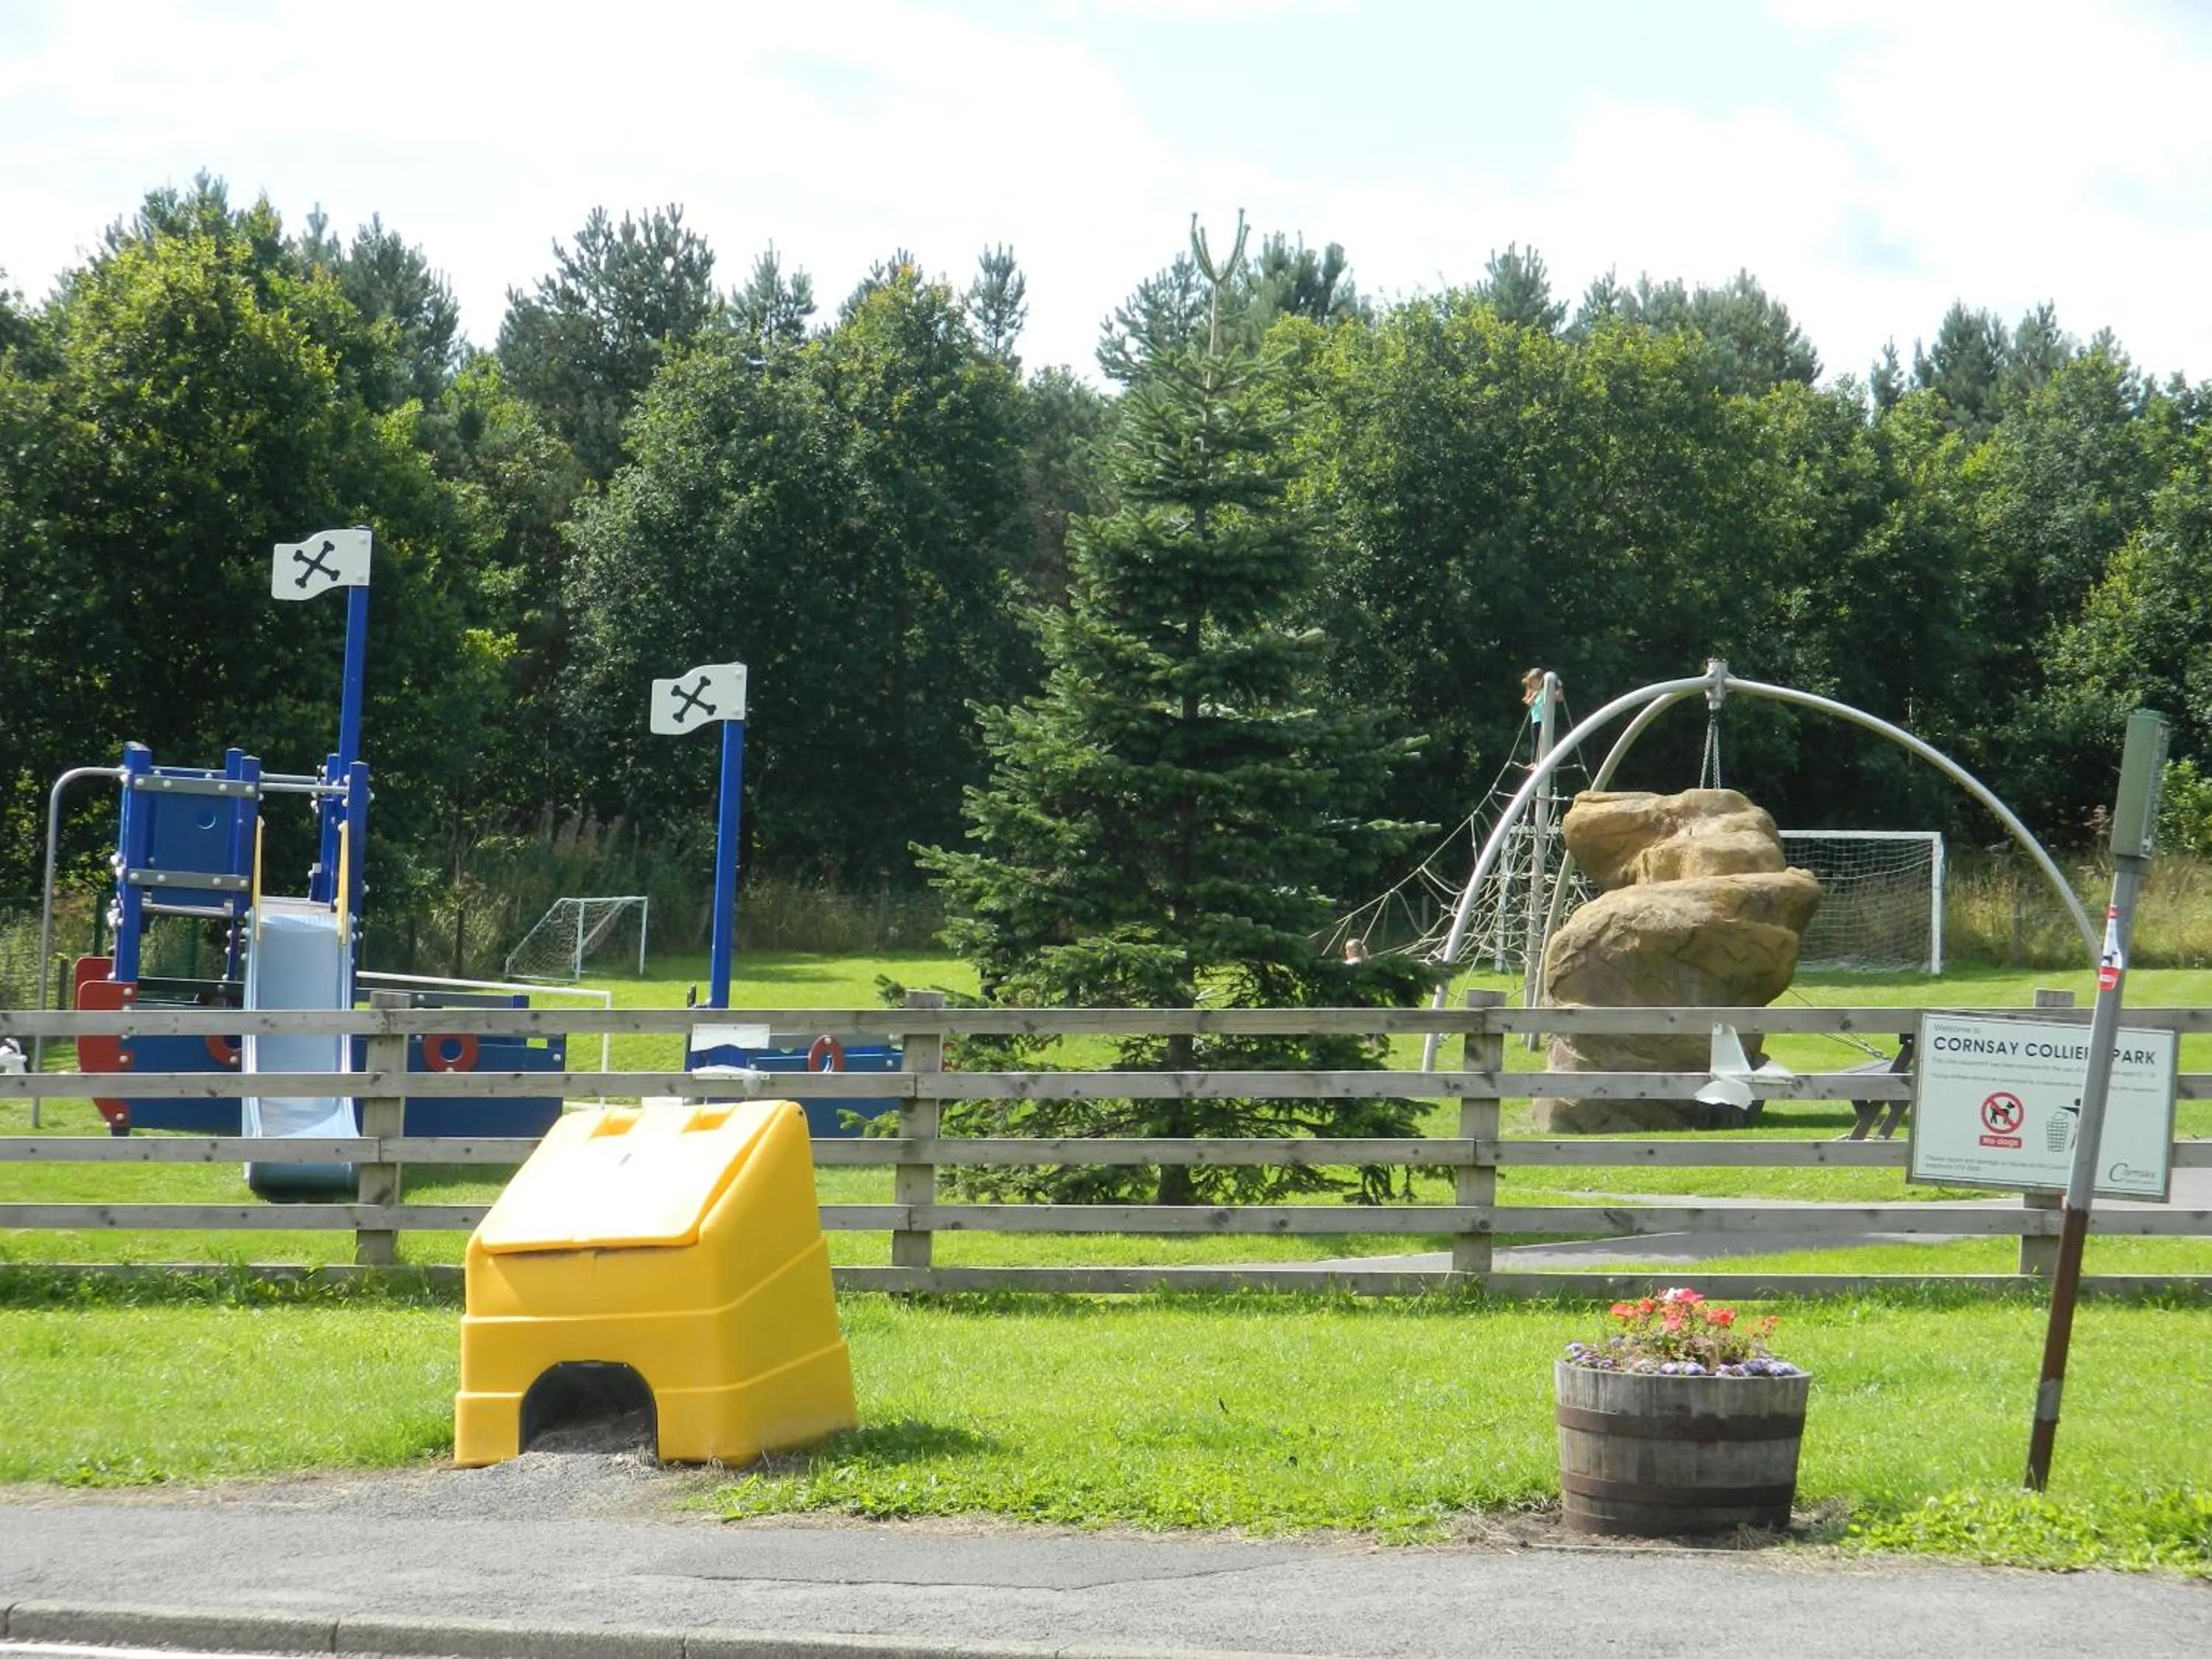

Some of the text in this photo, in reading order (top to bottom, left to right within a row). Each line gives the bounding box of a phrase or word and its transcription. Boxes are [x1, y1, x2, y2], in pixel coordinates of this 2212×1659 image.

[1933, 1023, 1972, 1034] Welcome
[1934, 1036, 2156, 1065] CORNSAY COLLIE PARK
